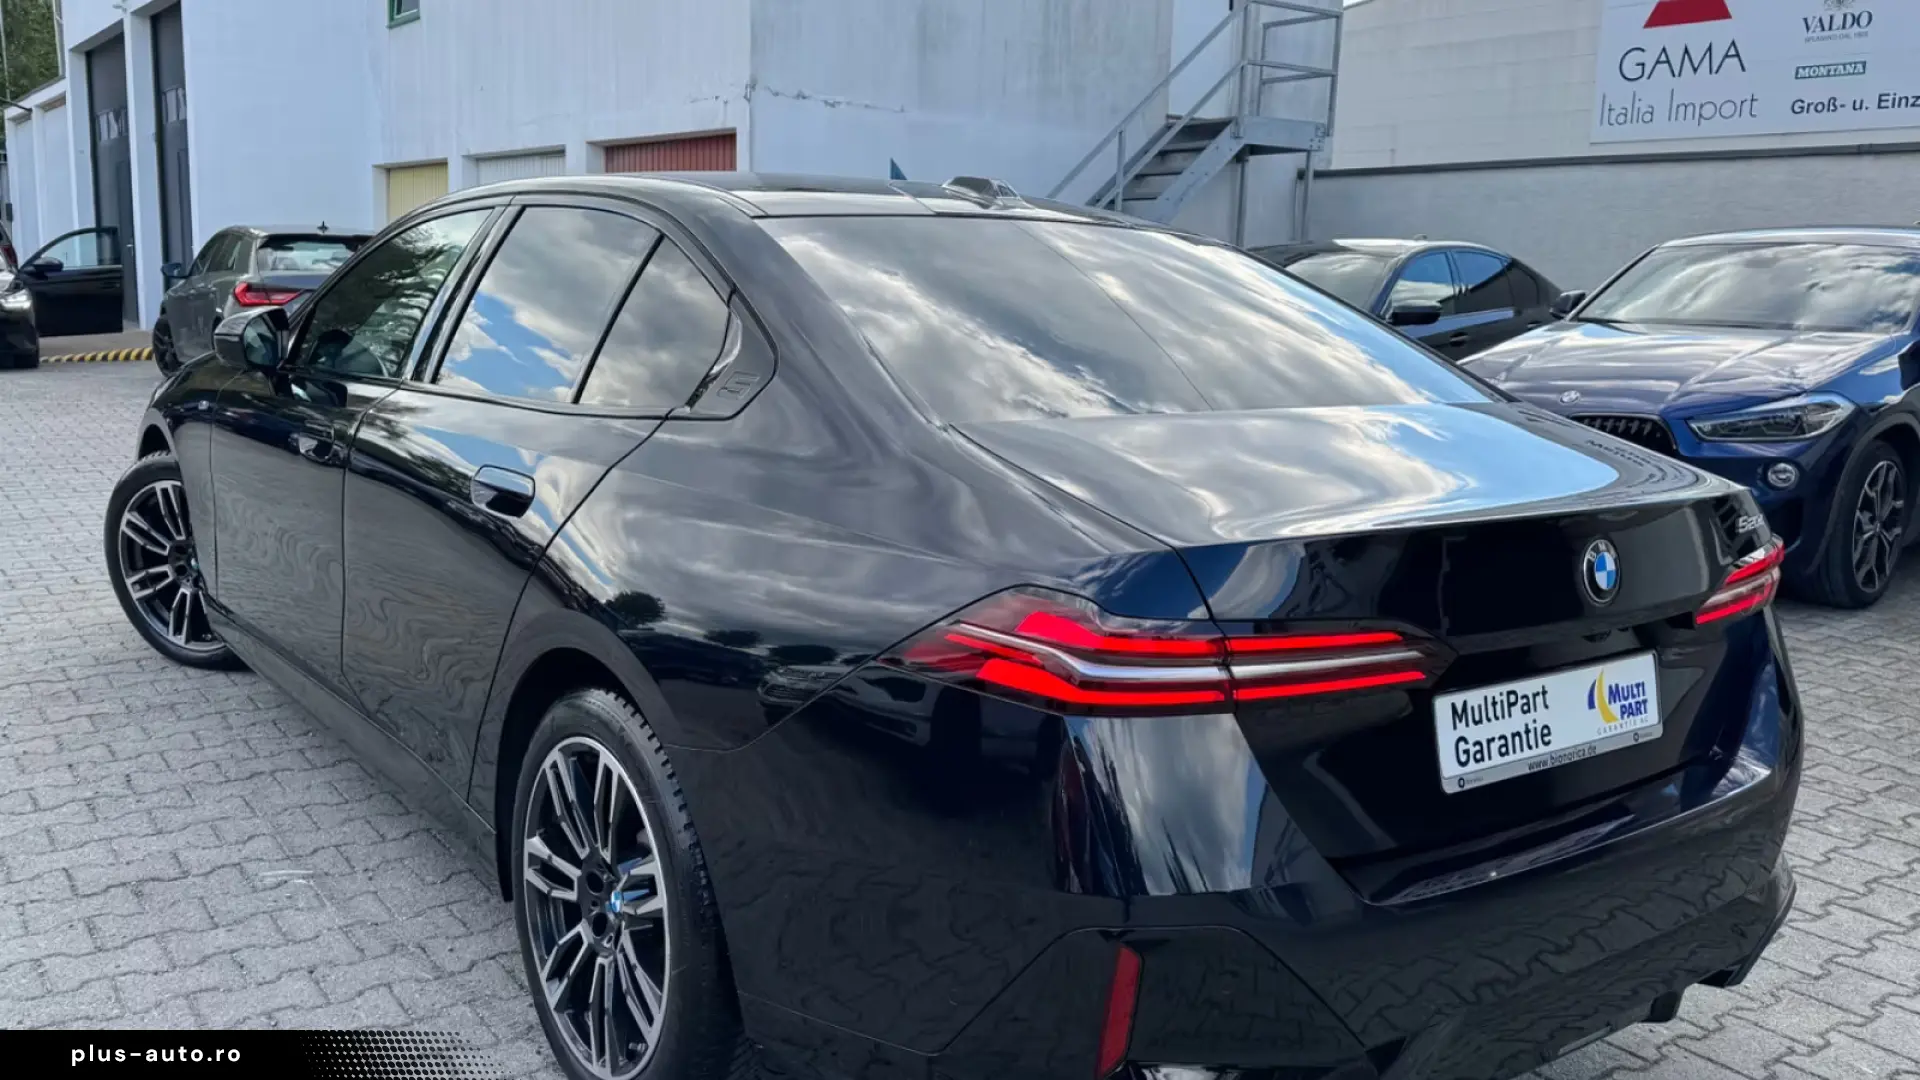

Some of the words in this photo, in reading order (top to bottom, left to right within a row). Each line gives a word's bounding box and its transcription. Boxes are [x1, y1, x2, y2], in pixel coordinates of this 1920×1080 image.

[1802, 10, 1873, 34] VALDO
[1618, 39, 1747, 82] GAMA
[1796, 62, 1866, 78] MONTANA
[1600, 90, 1654, 127] Italia
[1667, 88, 1759, 126] Import
[1790, 96, 1847, 115] Groß-
[1852, 98, 1870, 112] u.
[1608, 681, 1646, 705] MULTI
[1450, 685, 1549, 730] MultiPart
[1620, 698, 1648, 720] PART
[1455, 719, 1552, 768] Garantie
